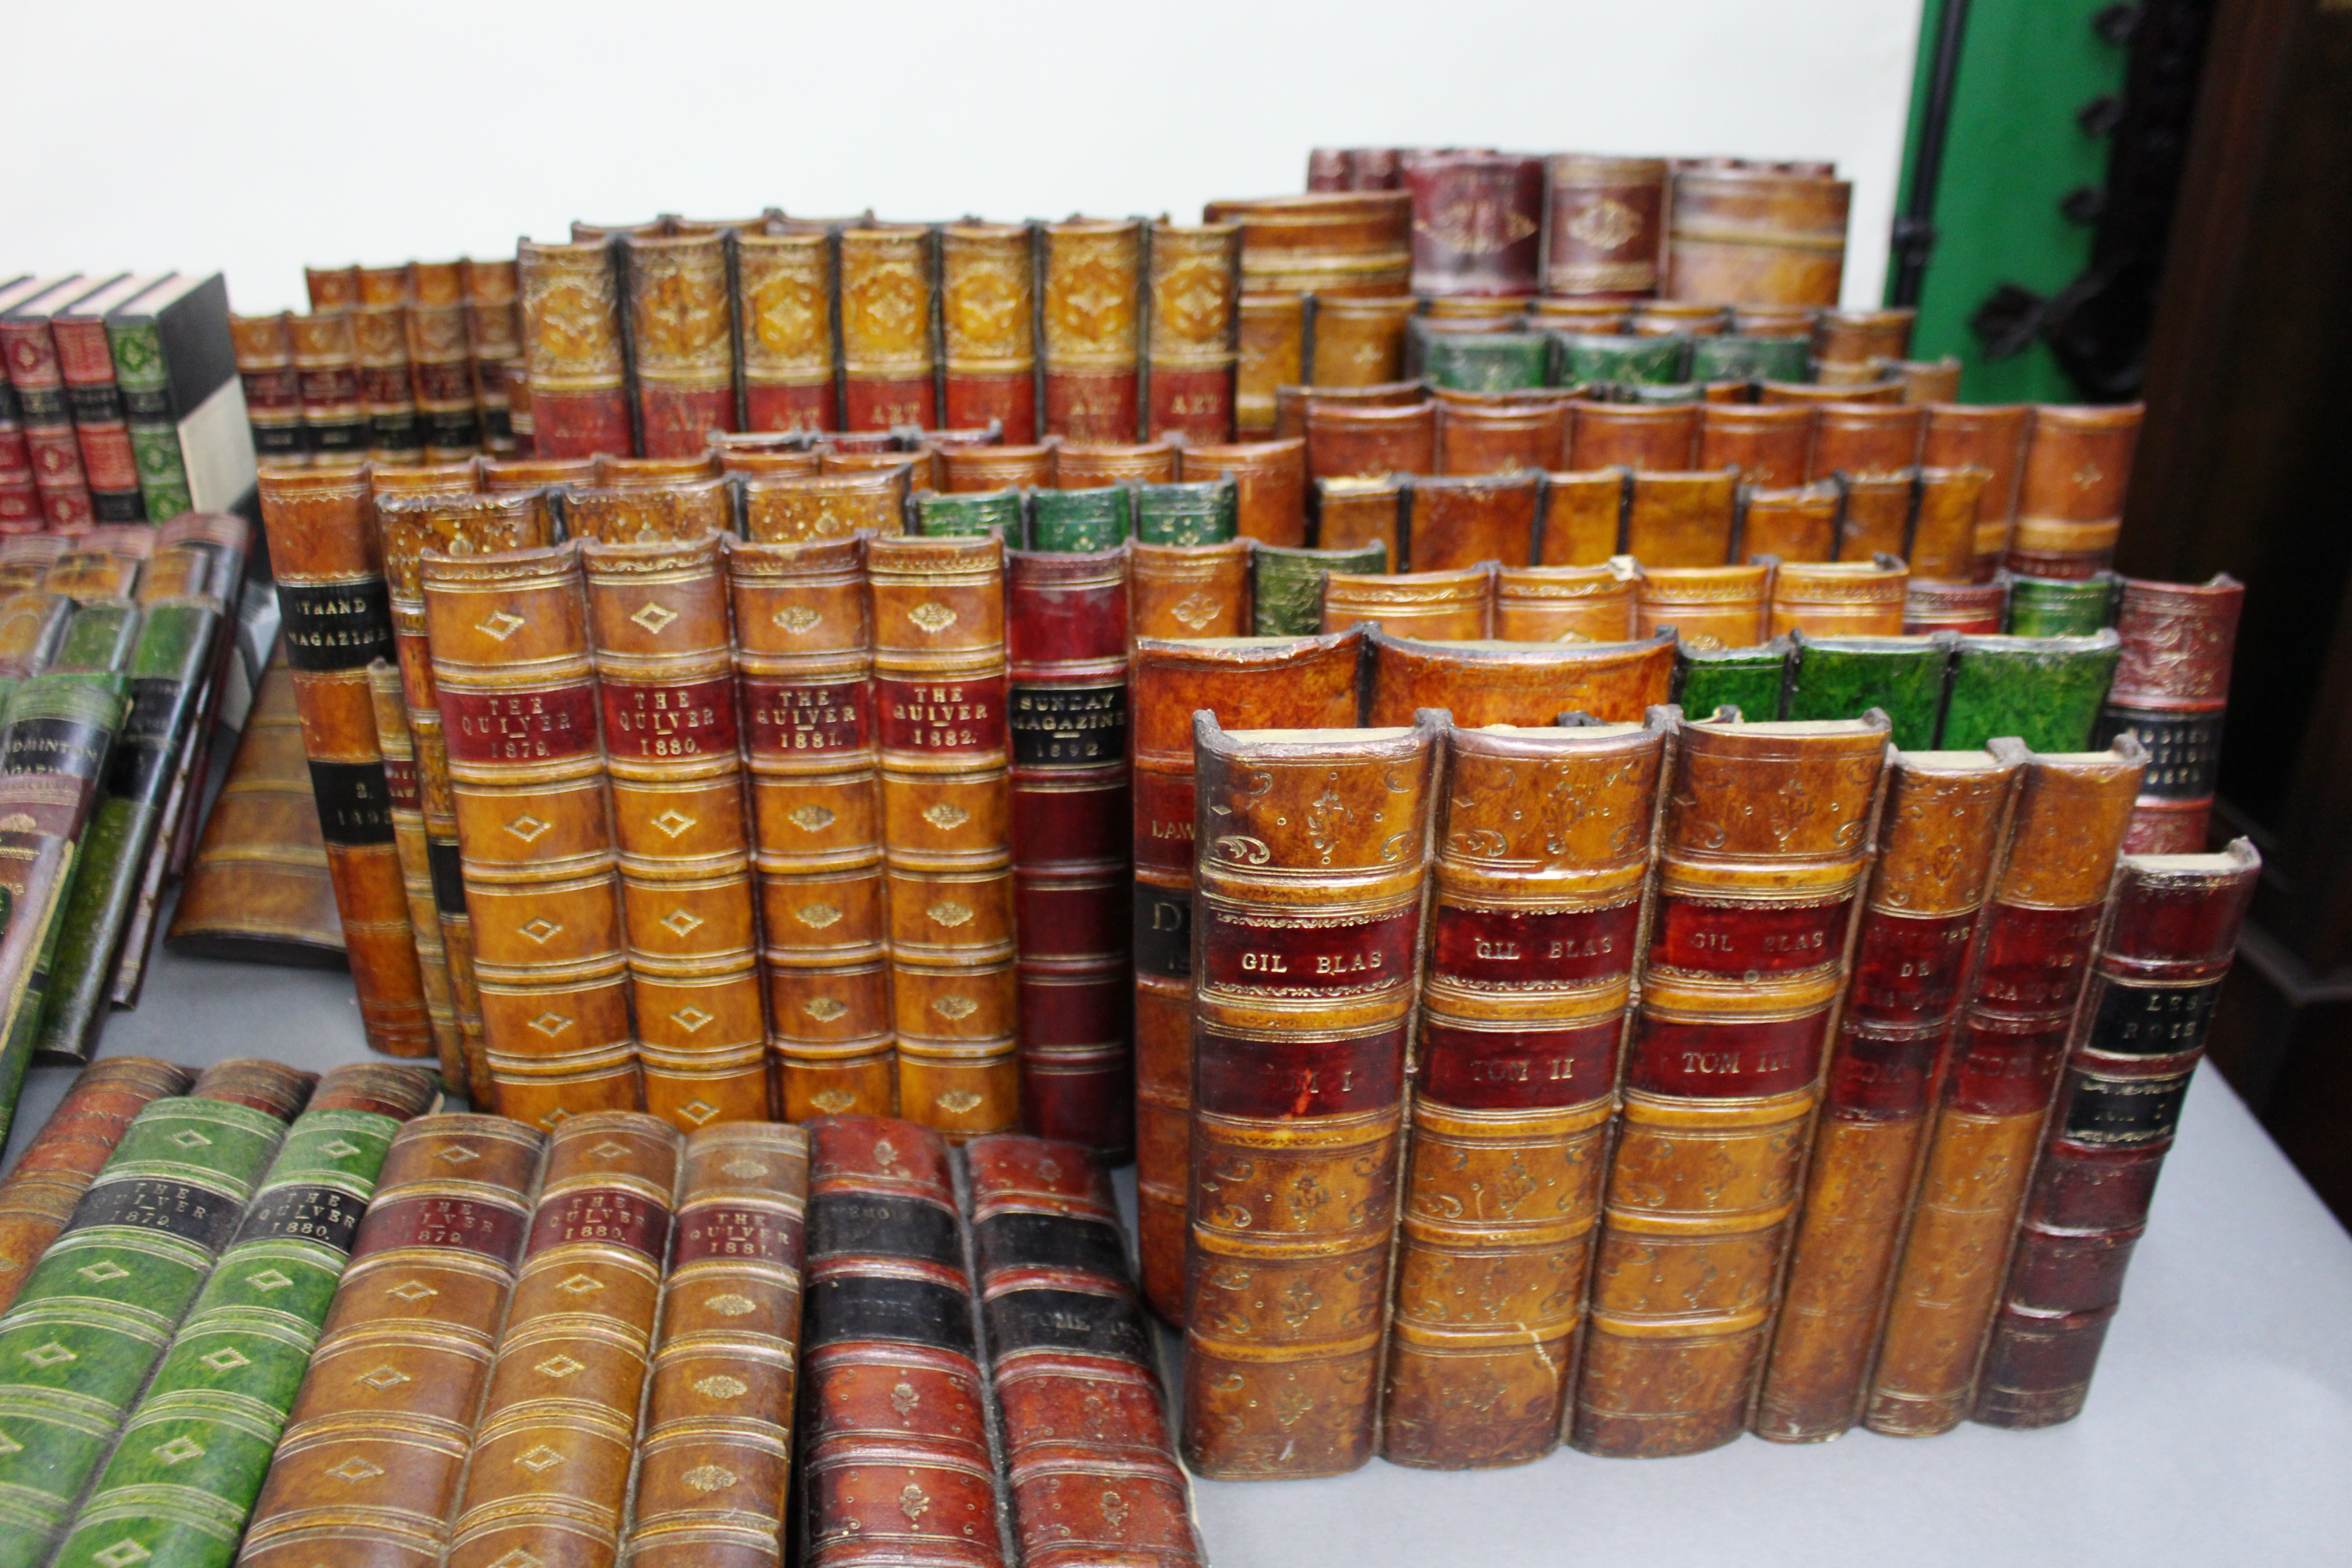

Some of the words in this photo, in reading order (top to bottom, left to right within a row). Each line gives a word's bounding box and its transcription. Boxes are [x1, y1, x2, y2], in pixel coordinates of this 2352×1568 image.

[296, 598, 366, 615] TRAND
[635, 690, 689, 709] THE
[779, 689, 829, 706] THE
[914, 686, 963, 703] THE
[1020, 693, 1114, 711] SUNDAY
[489, 696, 543, 715] THE
[893, 703, 988, 721] QUIVER
[462, 711, 571, 735] QUIVER
[620, 706, 715, 731] QUIVER
[757, 705, 856, 725] QUIVER
[1013, 711, 1125, 730] MAGAZINE
[641, 736, 701, 755] 1880.
[780, 731, 843, 749] 1881.
[914, 728, 977, 746] 1882.
[1476, 941, 1520, 960] GIL
[1549, 936, 1611, 958] BLAS
[1691, 933, 1734, 951] GIL
[1763, 931, 1823, 952] BLAS
[1242, 953, 1288, 973] GIL
[1316, 951, 1382, 974] BLAS
[2146, 994, 2199, 1011] LES
[1470, 1058, 1531, 1081] TOM
[1549, 1058, 1574, 1080] II
[1681, 1052, 1740, 1074] TOM
[1756, 1052, 1790, 1073] III
[1342, 1071, 1353, 1092] I
[135, 1182, 190, 1200] THE
[287, 1192, 340, 1207] THE
[418, 1202, 473, 1215] THE
[573, 1196, 626, 1208] THE
[109, 1210, 170, 1228] 1879.
[390, 1213, 493, 1233] IVER
[549, 1208, 646, 1228] QUIVER
[718, 1213, 765, 1225] THE
[272, 1222, 330, 1241] 1880.
[406, 1230, 463, 1244] 879.
[564, 1225, 626, 1241] 1880.
[690, 1226, 789, 1245] QUIVER
[710, 1241, 773, 1256] 1881.
